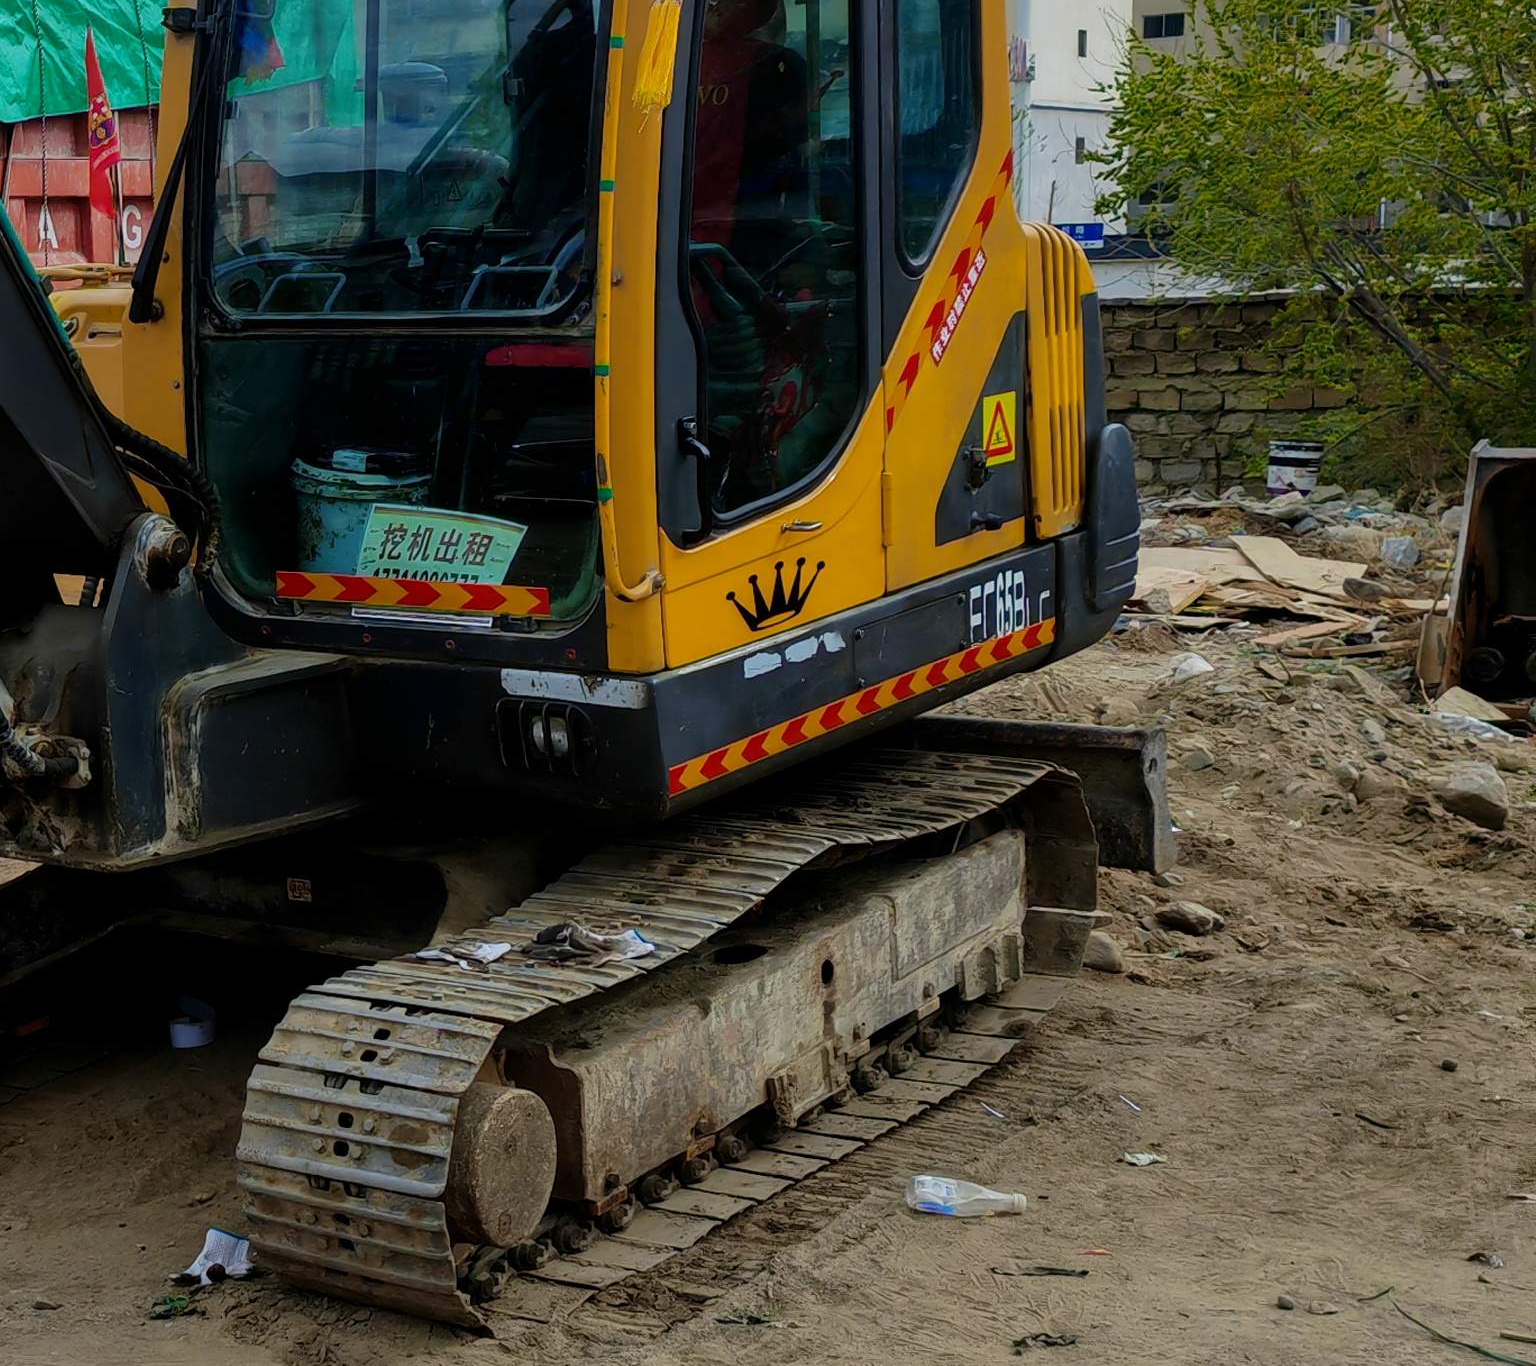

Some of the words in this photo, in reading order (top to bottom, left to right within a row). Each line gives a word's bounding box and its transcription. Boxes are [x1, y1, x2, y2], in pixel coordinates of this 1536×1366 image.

[38, 204, 59, 249] A
[122, 204, 142, 249] G
[378, 522, 495, 567] 挖机出租
